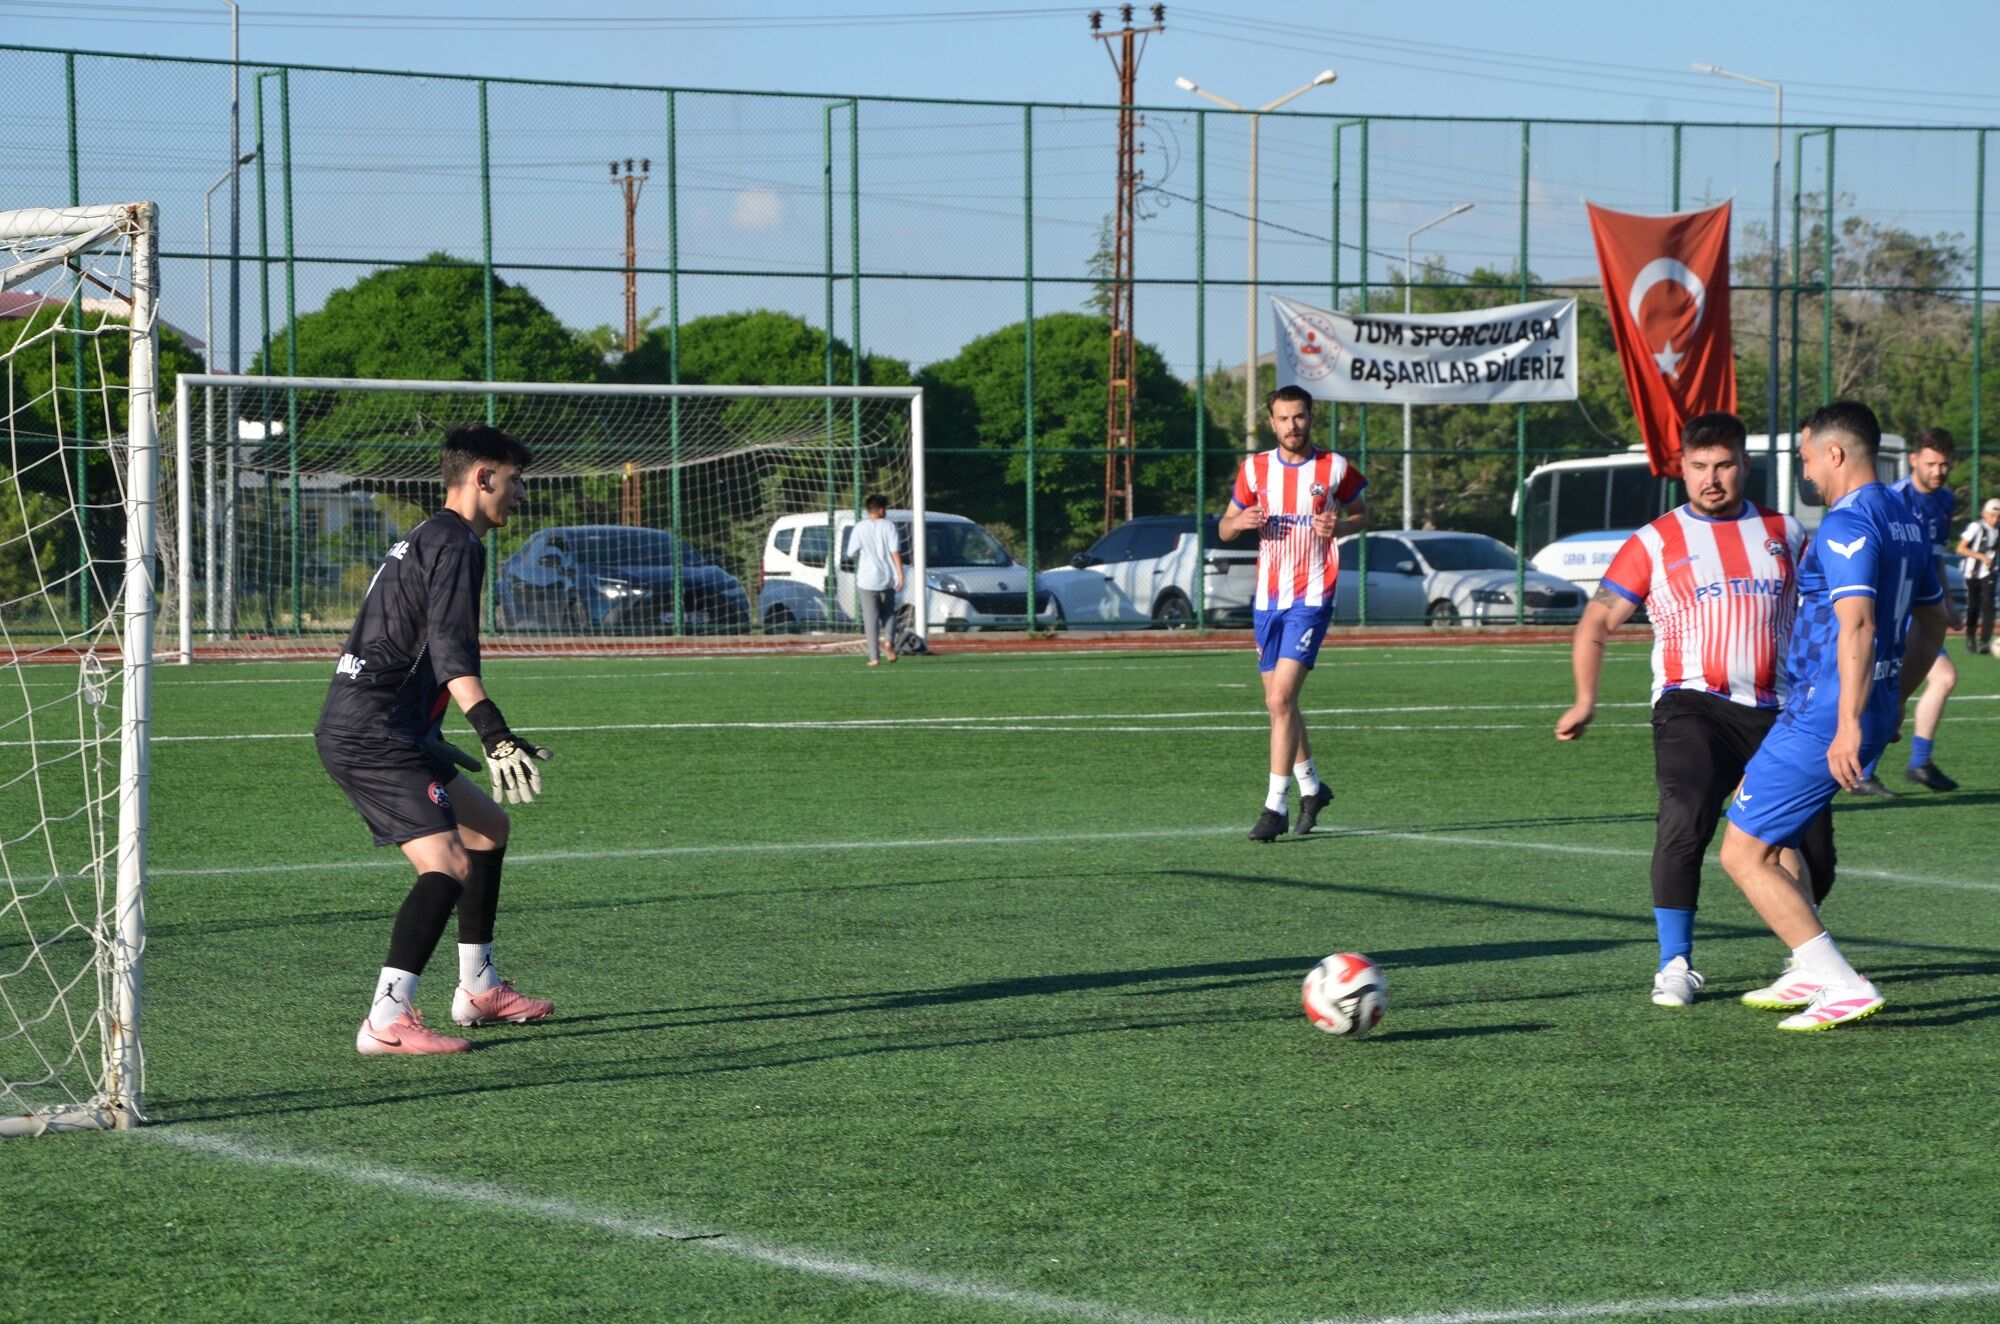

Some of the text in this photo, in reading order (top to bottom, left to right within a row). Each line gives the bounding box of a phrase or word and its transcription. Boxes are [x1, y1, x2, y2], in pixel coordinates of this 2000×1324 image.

[1350, 348, 1565, 389] BAŞARILAR DİLERİZ
[1695, 578, 1785, 601] PS TIME
[1300, 628, 1314, 647] 4
